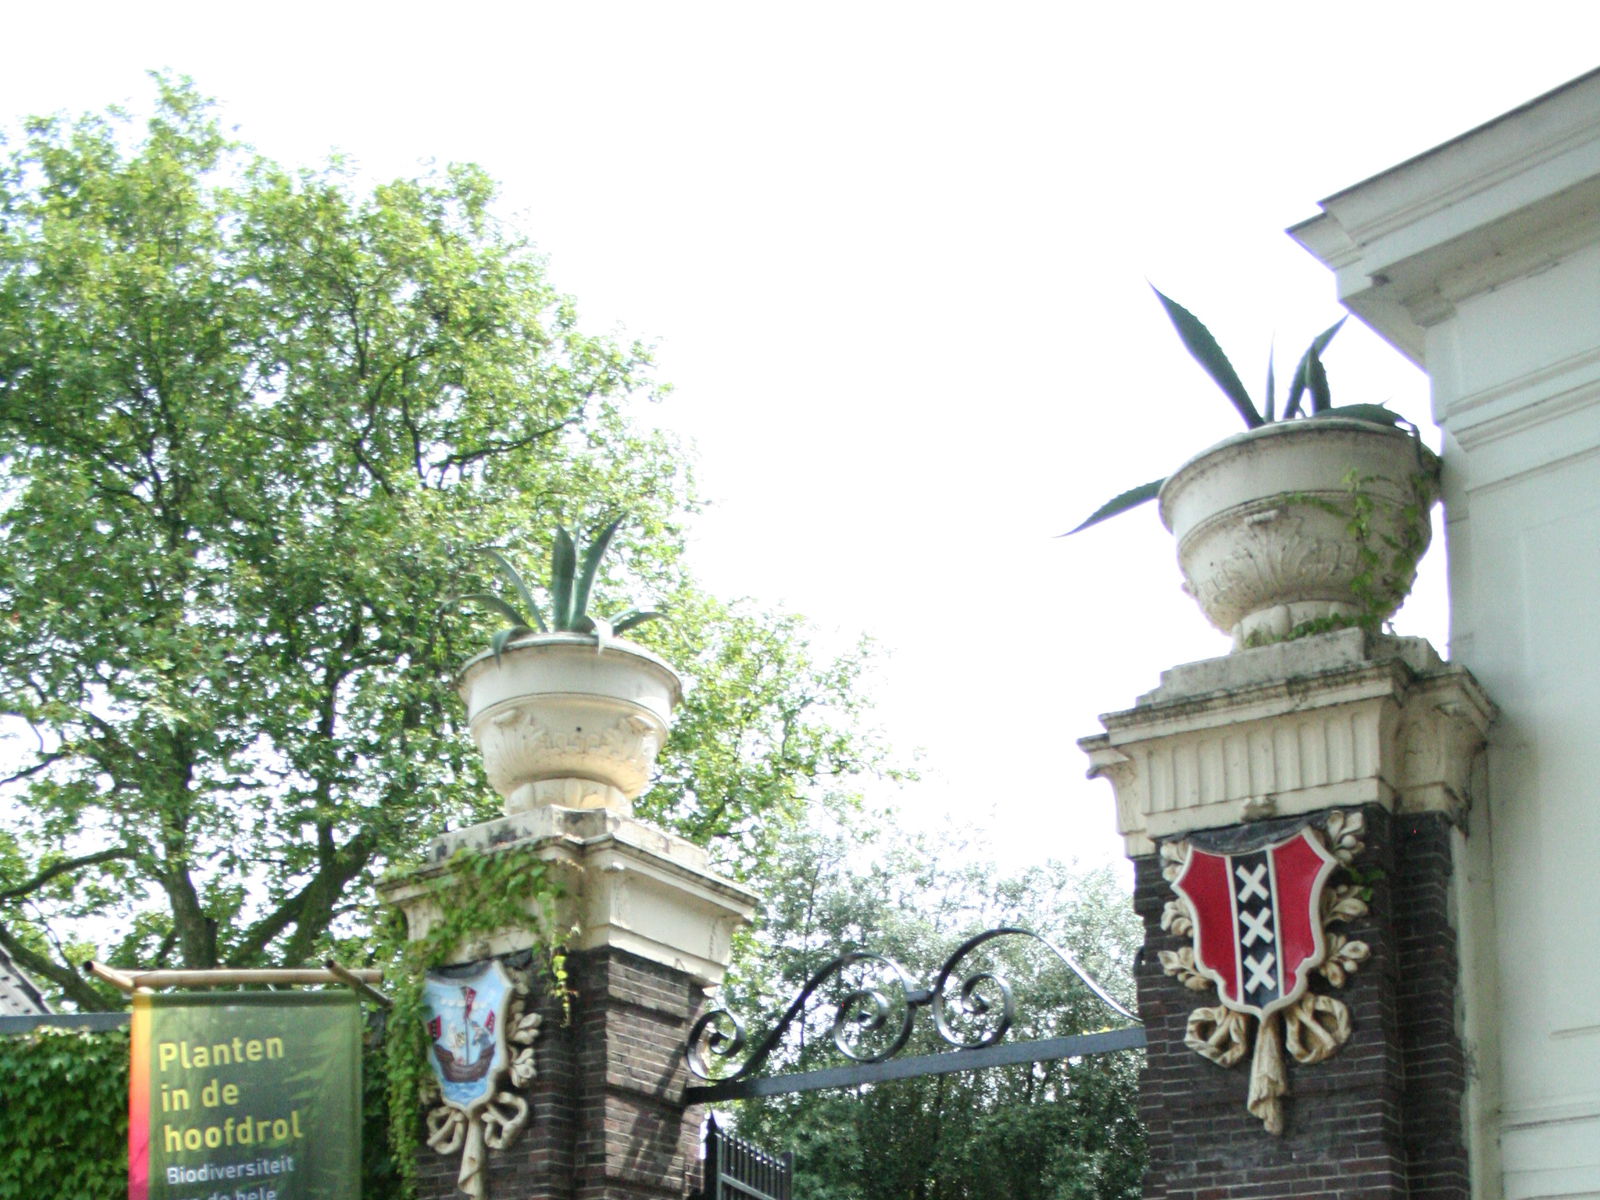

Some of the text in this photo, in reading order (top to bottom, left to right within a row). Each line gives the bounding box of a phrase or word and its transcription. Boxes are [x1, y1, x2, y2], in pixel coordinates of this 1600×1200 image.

[159, 1037, 284, 1072] Planten
[161, 1078, 239, 1112] in de
[164, 1110, 304, 1152] hoofdrol
[166, 1155, 295, 1185] Biodiversiteit
